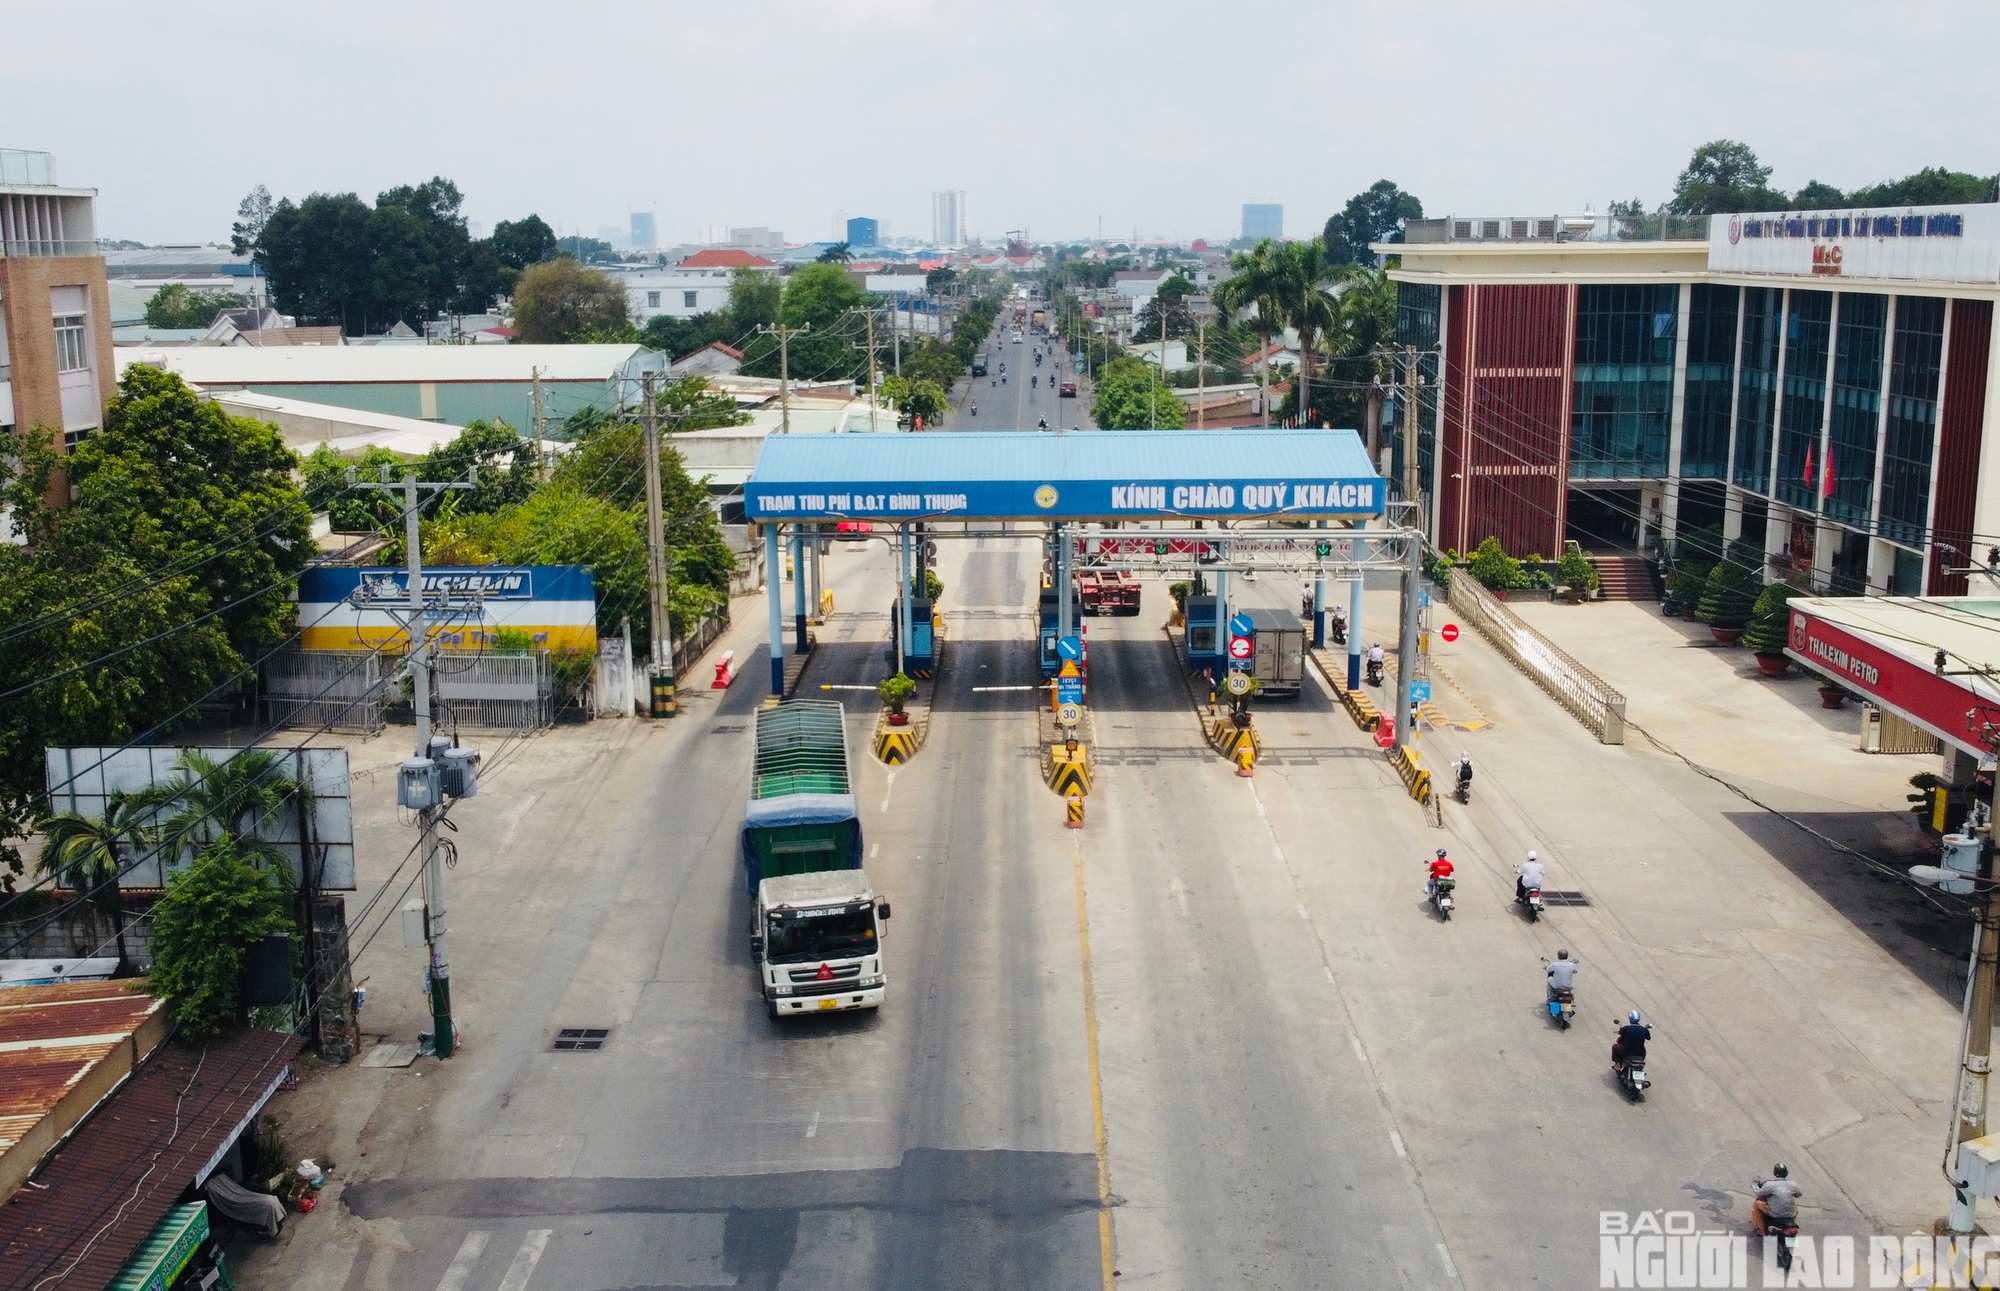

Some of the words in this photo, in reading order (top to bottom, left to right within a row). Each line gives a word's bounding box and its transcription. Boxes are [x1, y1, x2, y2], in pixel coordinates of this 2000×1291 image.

[758, 495, 796, 513] TRẠM
[799, 495, 826, 511] THU
[828, 492, 851, 511] PHÍ
[854, 494, 886, 511] B.O.T
[889, 492, 921, 510] BÌNH
[1111, 482, 1166, 509] KÍNH
[1173, 482, 1235, 509] CHÀO
[1242, 481, 1286, 511] QUÝ
[1294, 481, 1373, 508] KHÁCH
[1809, 635, 1849, 670] THALEXIM
[1850, 657, 1879, 685] PETRO
[1232, 679, 1246, 689] 30
[1063, 709, 1077, 719] 30
